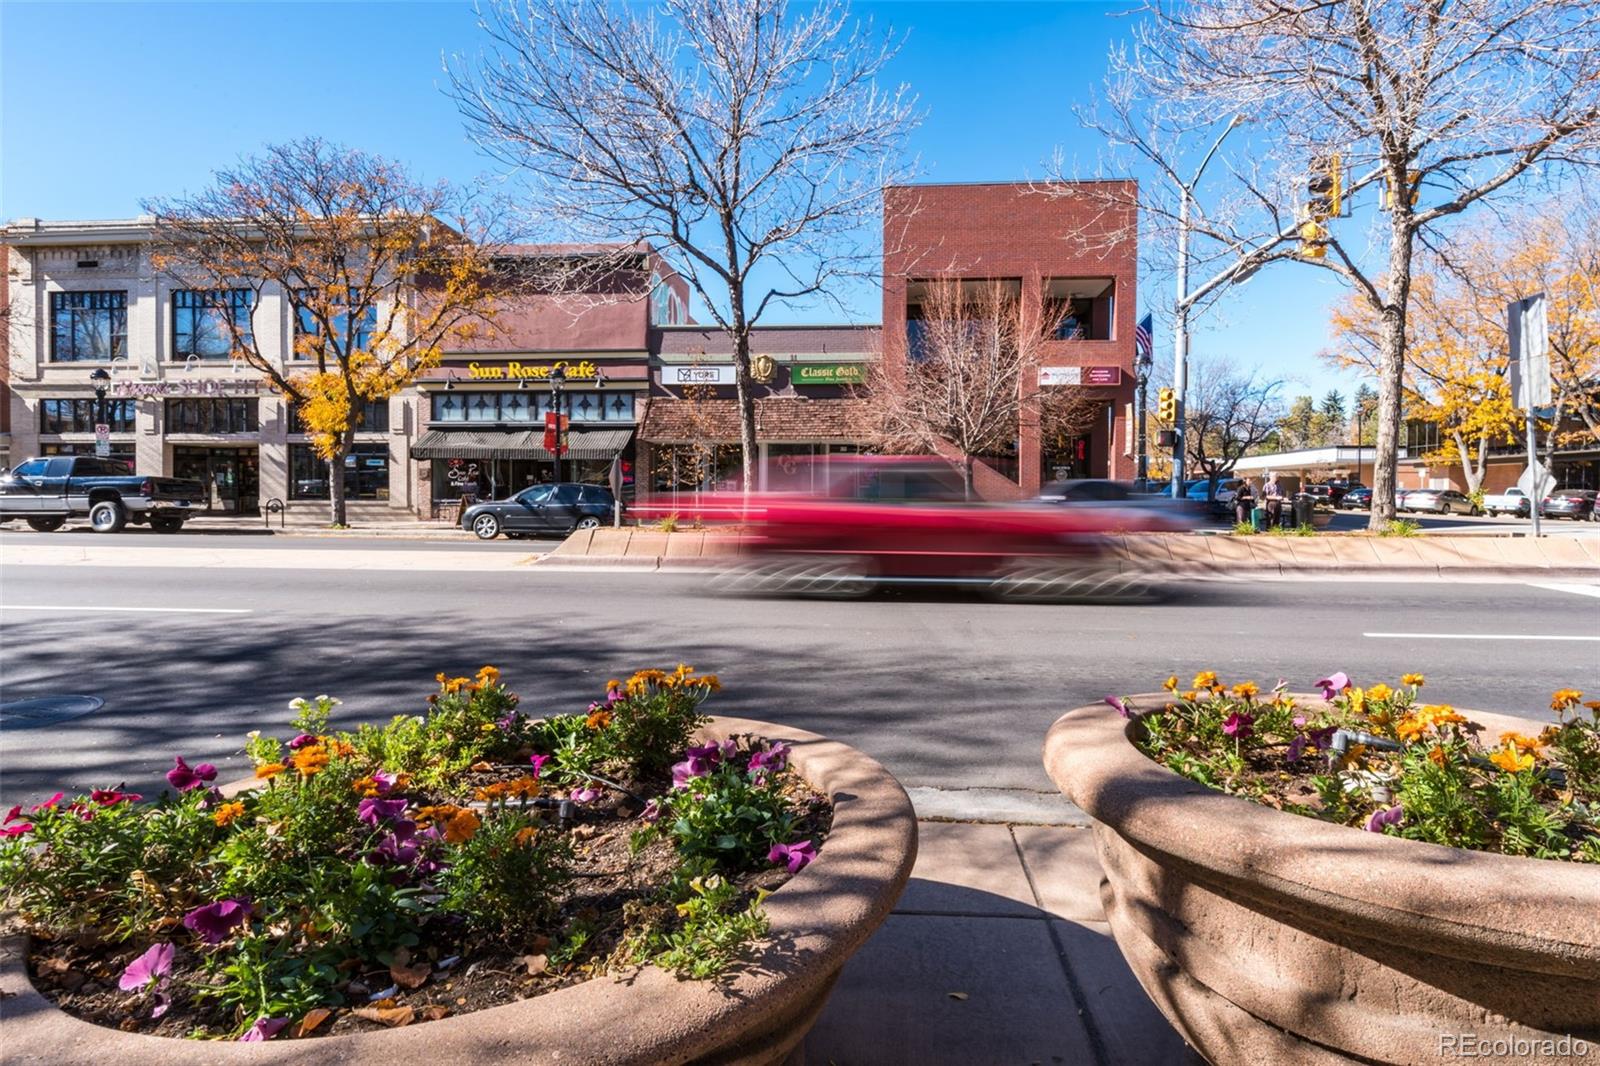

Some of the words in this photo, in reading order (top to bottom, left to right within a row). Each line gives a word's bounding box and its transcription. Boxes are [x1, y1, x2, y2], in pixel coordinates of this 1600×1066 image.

[468, 362, 502, 378] Sun
[508, 362, 549, 378] Rose
[801, 367, 833, 377] Classic
[836, 366, 859, 377] Gold
